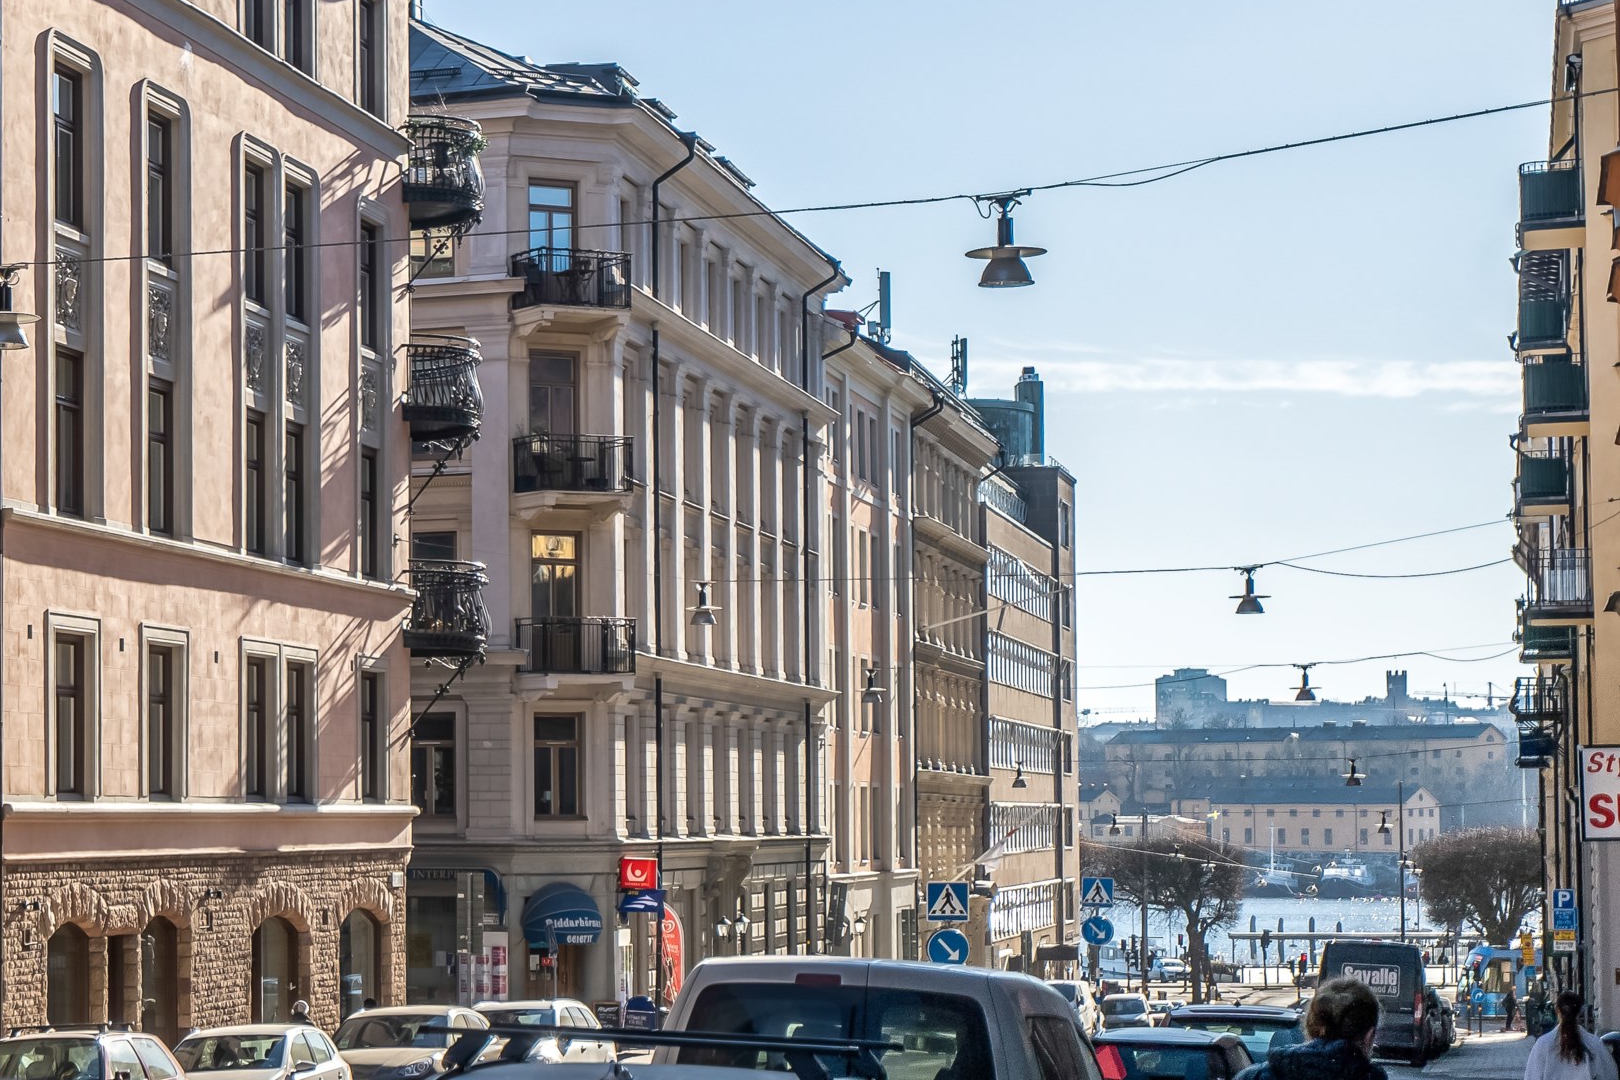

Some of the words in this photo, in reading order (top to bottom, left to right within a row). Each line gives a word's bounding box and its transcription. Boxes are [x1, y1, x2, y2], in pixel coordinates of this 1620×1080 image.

[1587, 751, 1620, 778] St
[1589, 793, 1620, 828] S
[412, 869, 457, 879] INTERP
[1558, 891, 1571, 908] P
